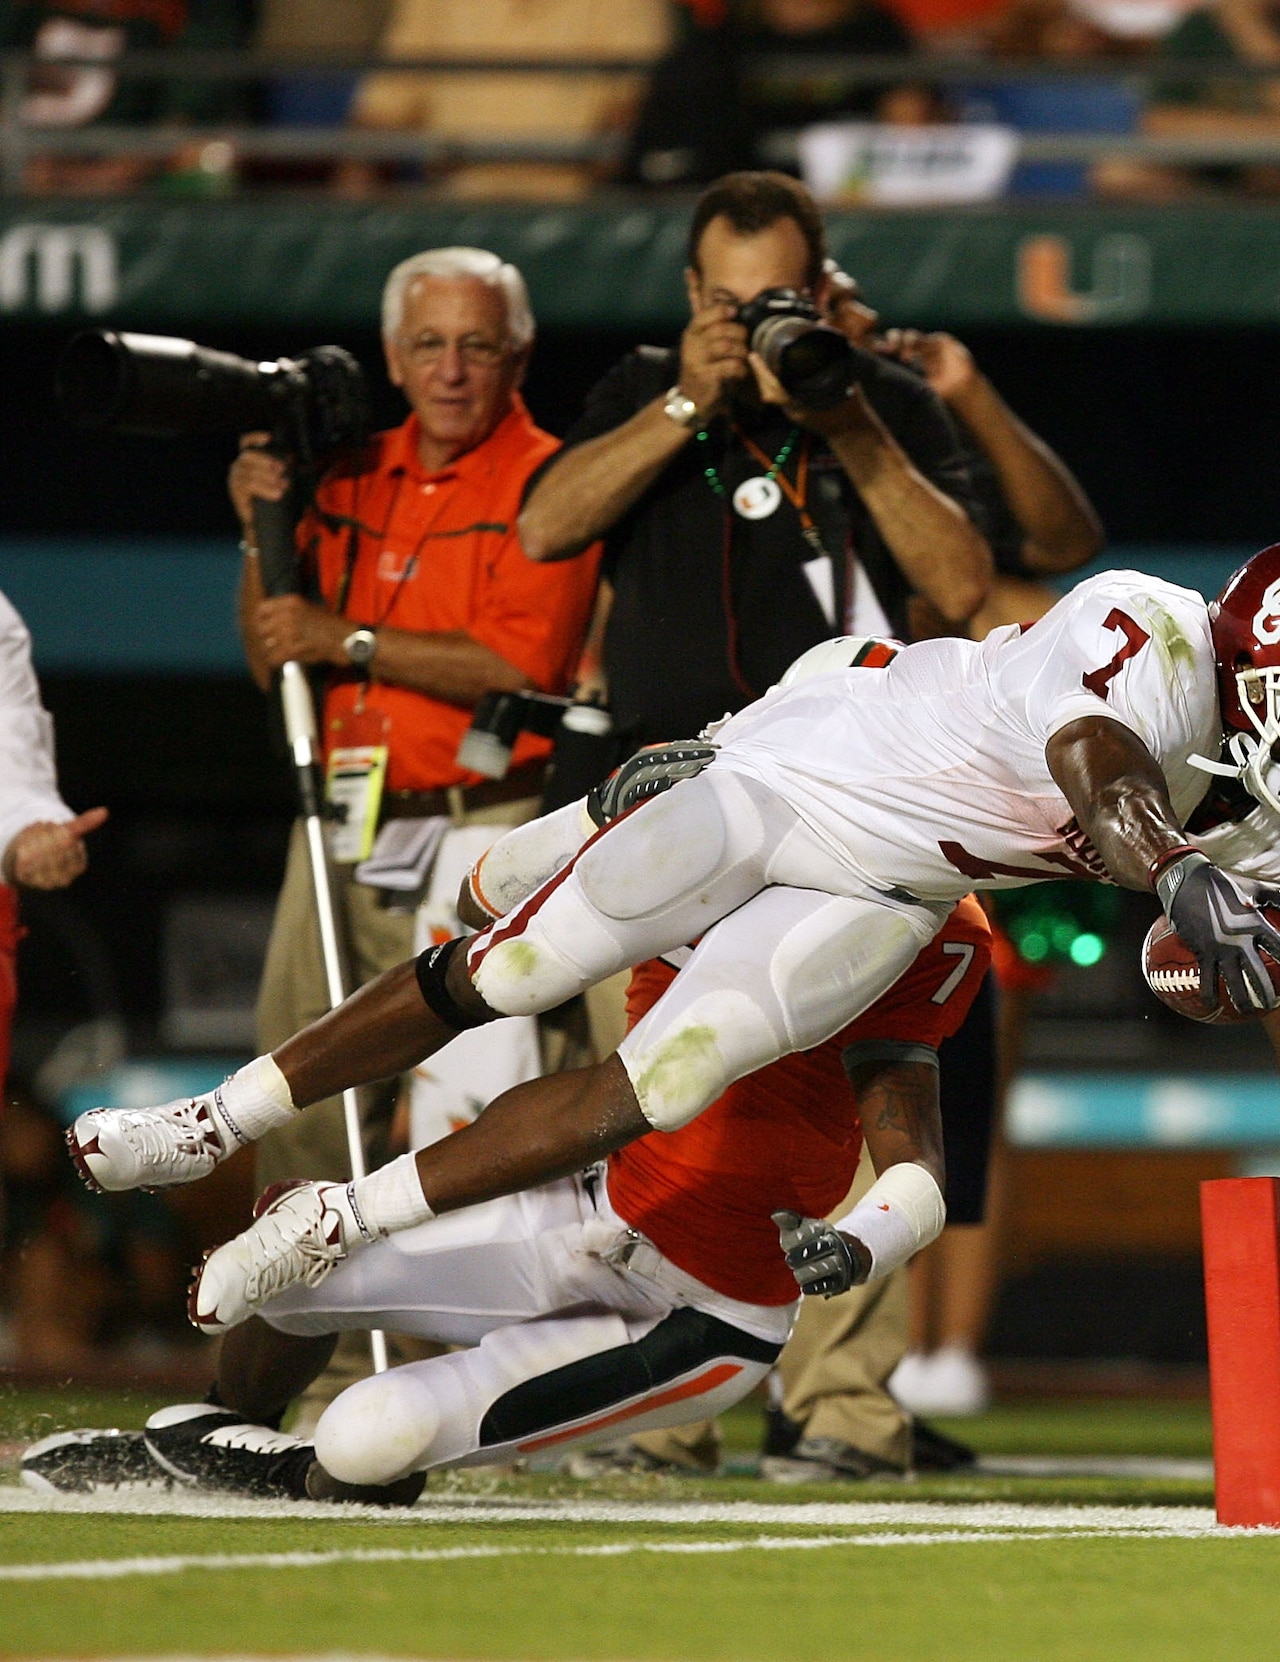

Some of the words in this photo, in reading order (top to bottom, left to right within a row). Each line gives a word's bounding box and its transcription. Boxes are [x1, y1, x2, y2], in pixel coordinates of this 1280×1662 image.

[1017, 234, 1151, 323] U
[1082, 607, 1151, 701] 7
[930, 941, 976, 1005] 7
